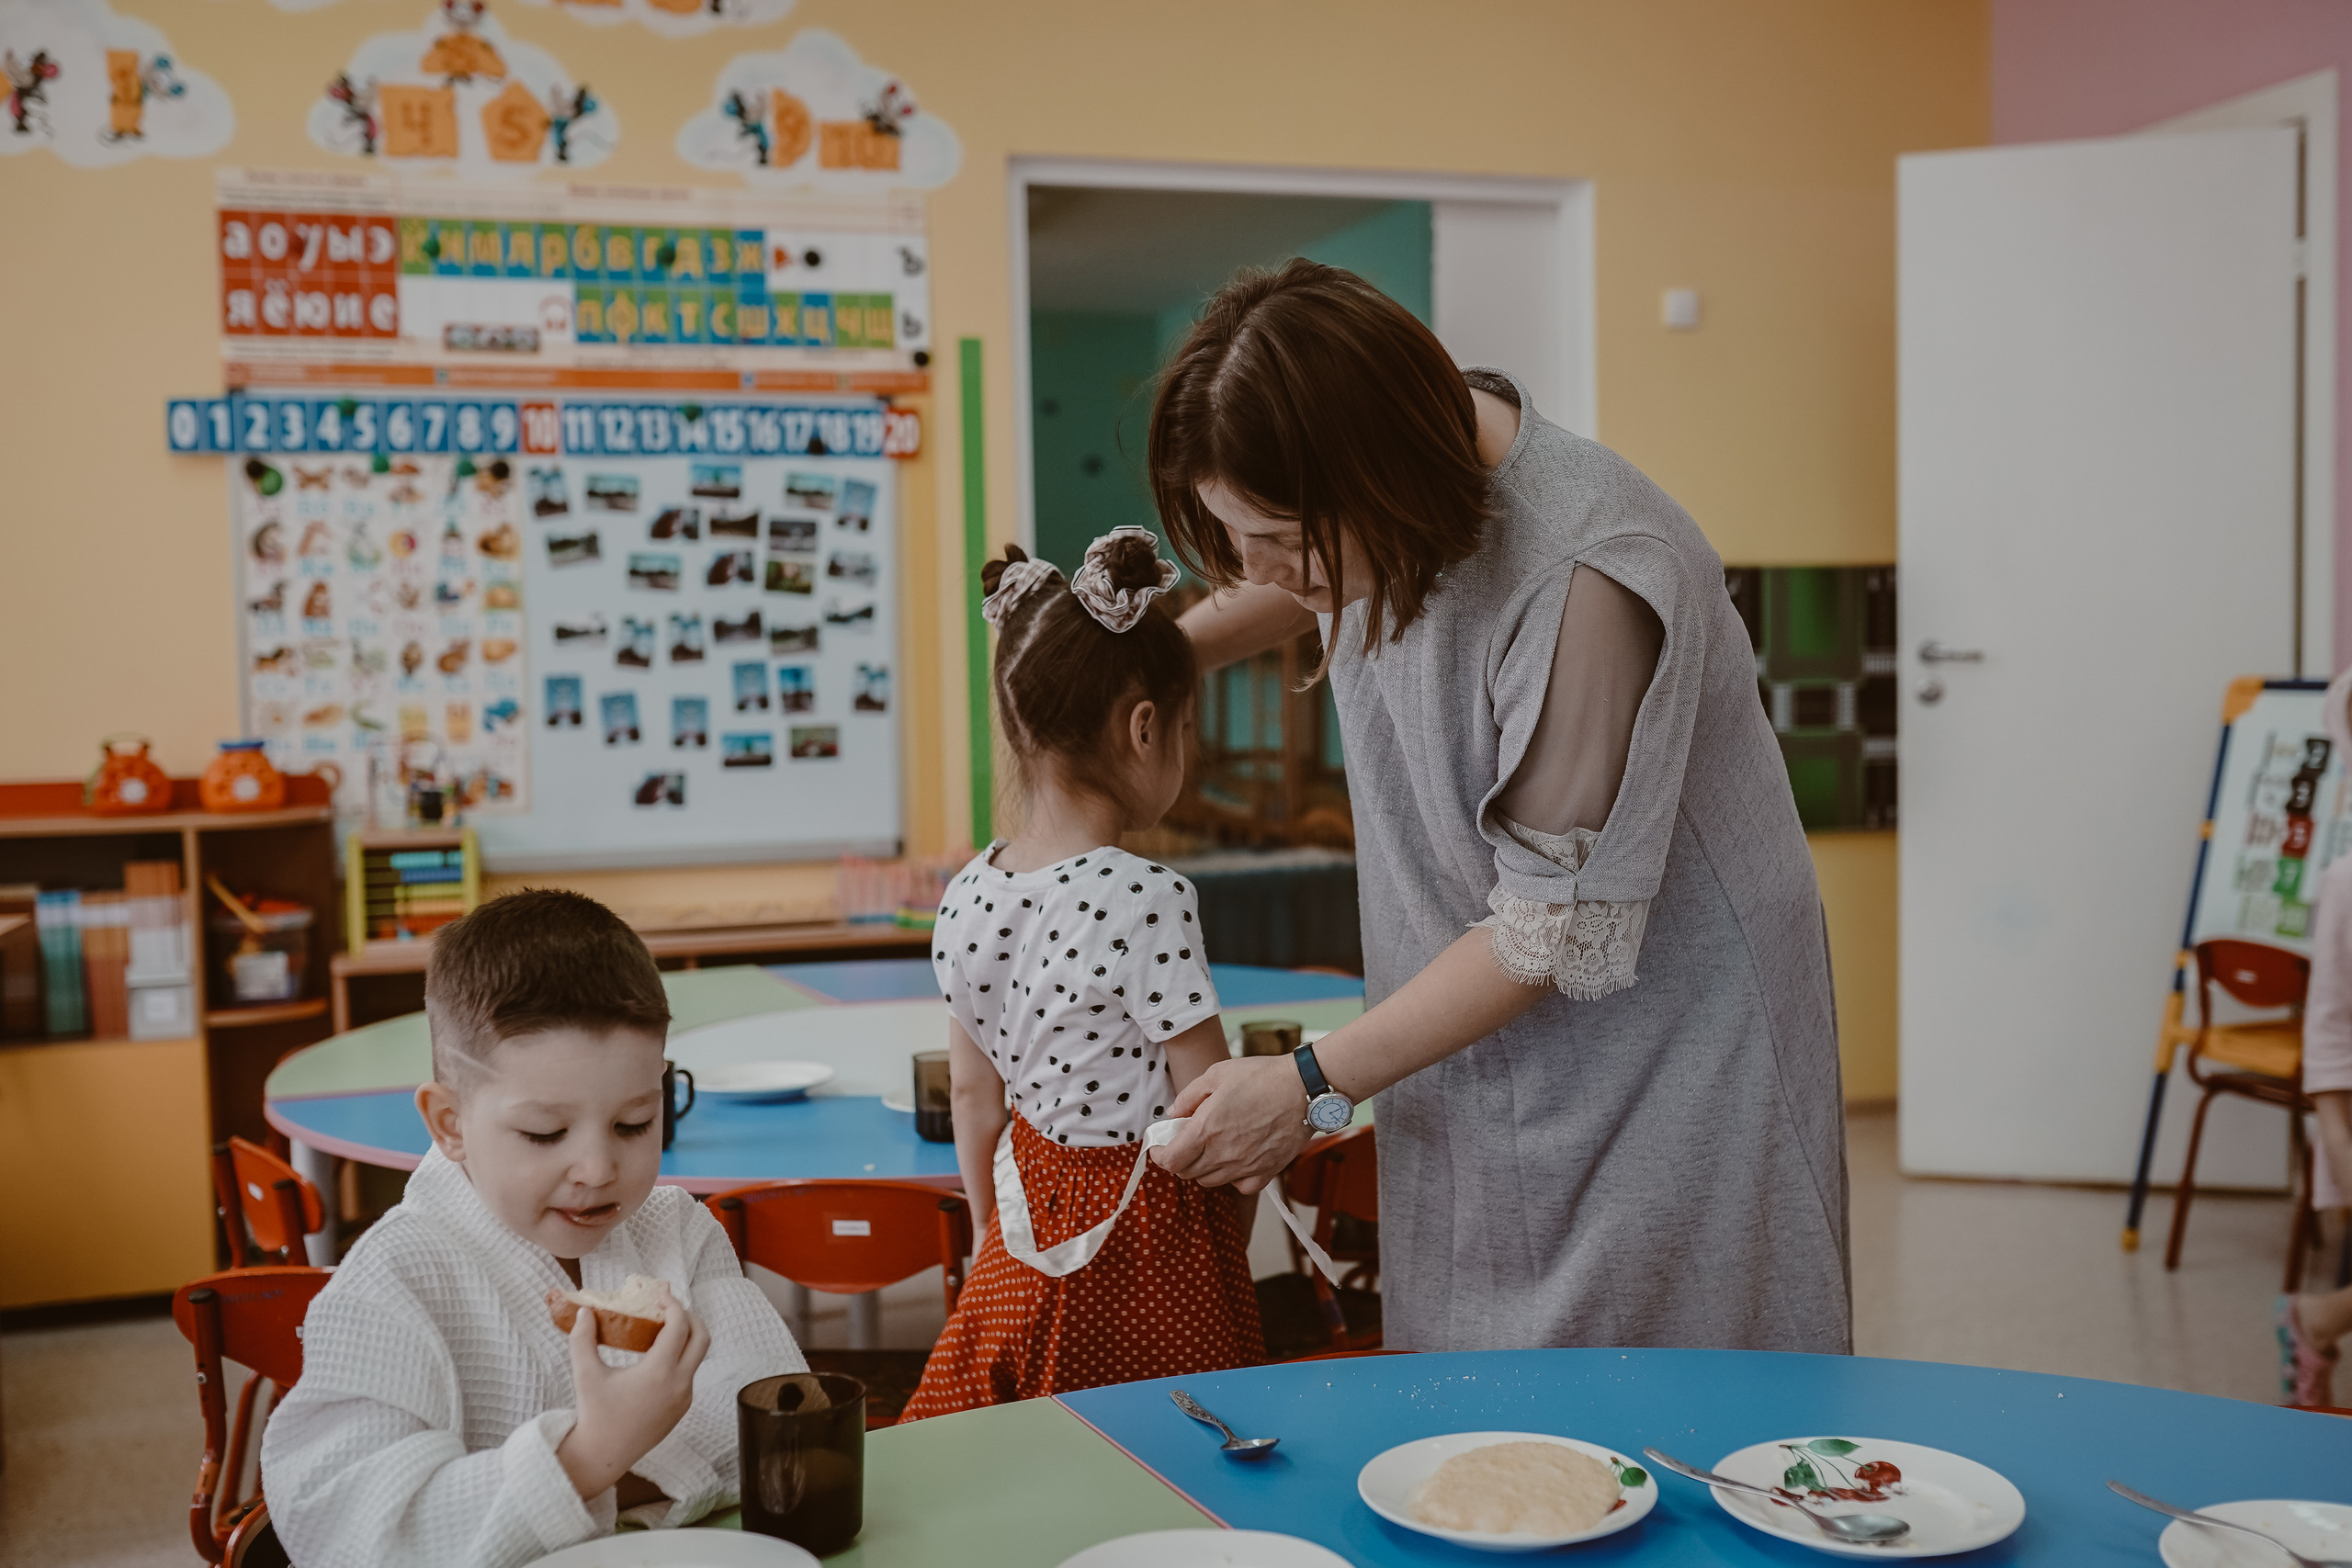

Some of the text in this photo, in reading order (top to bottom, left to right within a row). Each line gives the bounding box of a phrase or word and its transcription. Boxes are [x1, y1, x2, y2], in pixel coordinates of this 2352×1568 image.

[170, 402, 198, 451] 0
[208, 404, 232, 450] 1
[243, 403, 270, 450] 2
[280, 403, 305, 450] 3
[315, 403, 341, 450] 4
[352, 404, 376, 450] 5
[387, 404, 413, 450] 6
[422, 404, 447, 450] 7
[457, 404, 482, 450] 8
[491, 404, 516, 450] 9
[523, 407, 555, 454] 10
[564, 407, 594, 454] 11
[599, 407, 635, 454] 12
[638, 407, 672, 454] 13
[711, 408, 744, 454] 15
[747, 409, 781, 454] 16
[782, 409, 812, 454] 17
[852, 409, 883, 454] 19
[885, 410, 918, 455] 20
